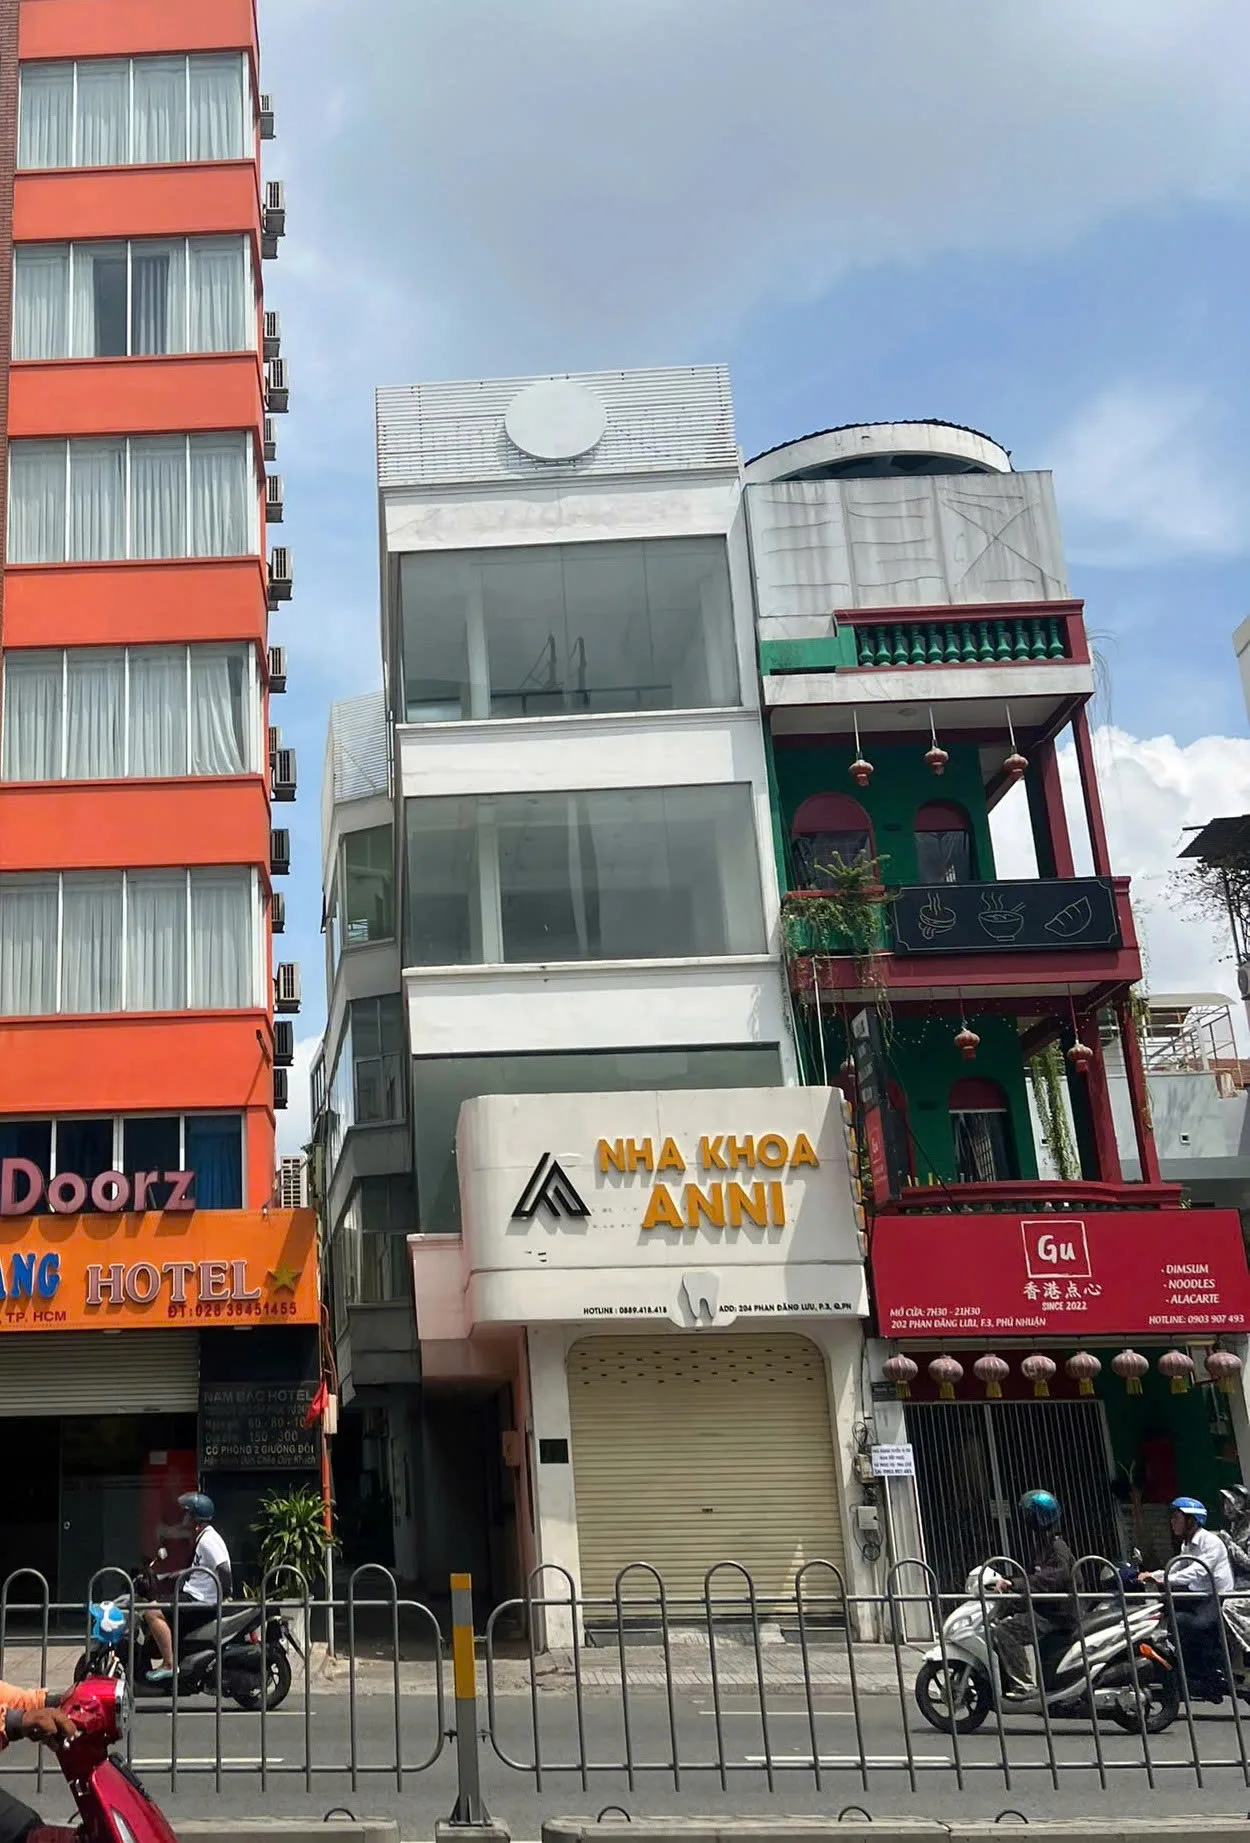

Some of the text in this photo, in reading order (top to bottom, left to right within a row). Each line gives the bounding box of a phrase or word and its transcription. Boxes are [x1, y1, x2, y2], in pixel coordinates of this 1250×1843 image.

[597, 1133, 820, 1173] NHA KHOA
[1, 1158, 196, 1215] Doorz
[641, 1181, 786, 1229] ANNI
[1037, 1234, 1076, 1265] Gu
[1166, 1264, 1209, 1275] DIMSUM
[86, 1260, 261, 1304] HOTEL
[1168, 1278, 1215, 1290] NOODLES
[1023, 1280, 1102, 1301] 香港点心
[1170, 1293, 1220, 1305] ALACARTE
[226, 1301, 297, 1317] 38451455
[583, 1307, 614, 1315] HOTLINE
[739, 1304, 752, 1312] 204
[754, 1304, 775, 1312] PHAN
[926, 1307, 947, 1317] 7H30
[954, 1307, 981, 1316] 21H30
[1041, 1301, 1088, 1311] SINCE 2022
[34, 1310, 66, 1322] HCM
[1148, 1314, 1245, 1325] HOTLINE: 0903 907 493
[891, 1319, 907, 1329] 202
[908, 1319, 933, 1329] PHAN
